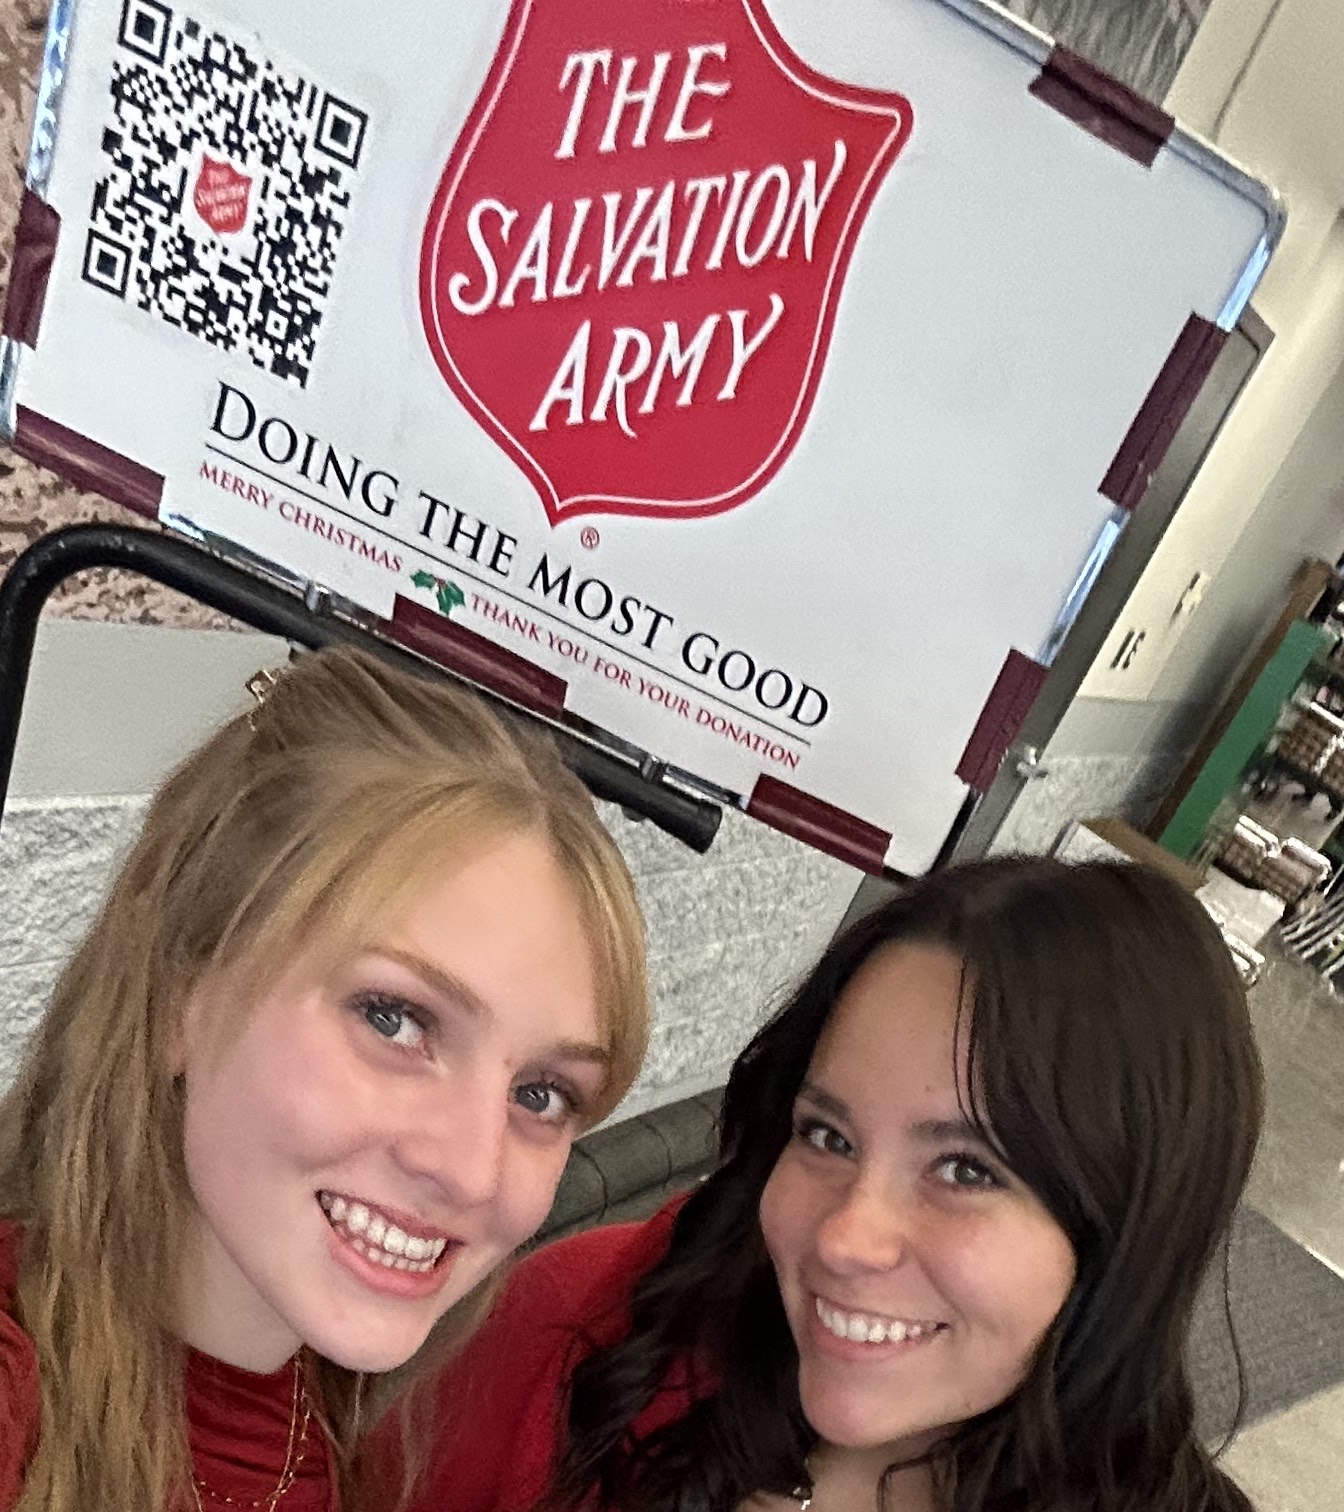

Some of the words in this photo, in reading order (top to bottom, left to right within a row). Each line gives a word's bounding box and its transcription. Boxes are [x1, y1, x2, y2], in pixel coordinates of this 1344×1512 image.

[553, 41, 733, 159] THE
[447, 139, 848, 316] SALVATION
[528, 293, 785, 439] ARMY
[199, 459, 274, 509] MERRY
[278, 501, 403, 572] CHRISTMAS
[209, 379, 400, 518] DOING
[418, 489, 519, 577] THE
[527, 552, 674, 650] MOST
[681, 631, 829, 728] GOOD
[470, 593, 541, 641] THANK
[546, 630, 589, 666] YOU
[593, 656, 632, 690] FOR
[637, 674, 691, 720] YOUR
[695, 706, 802, 771] DONATION
